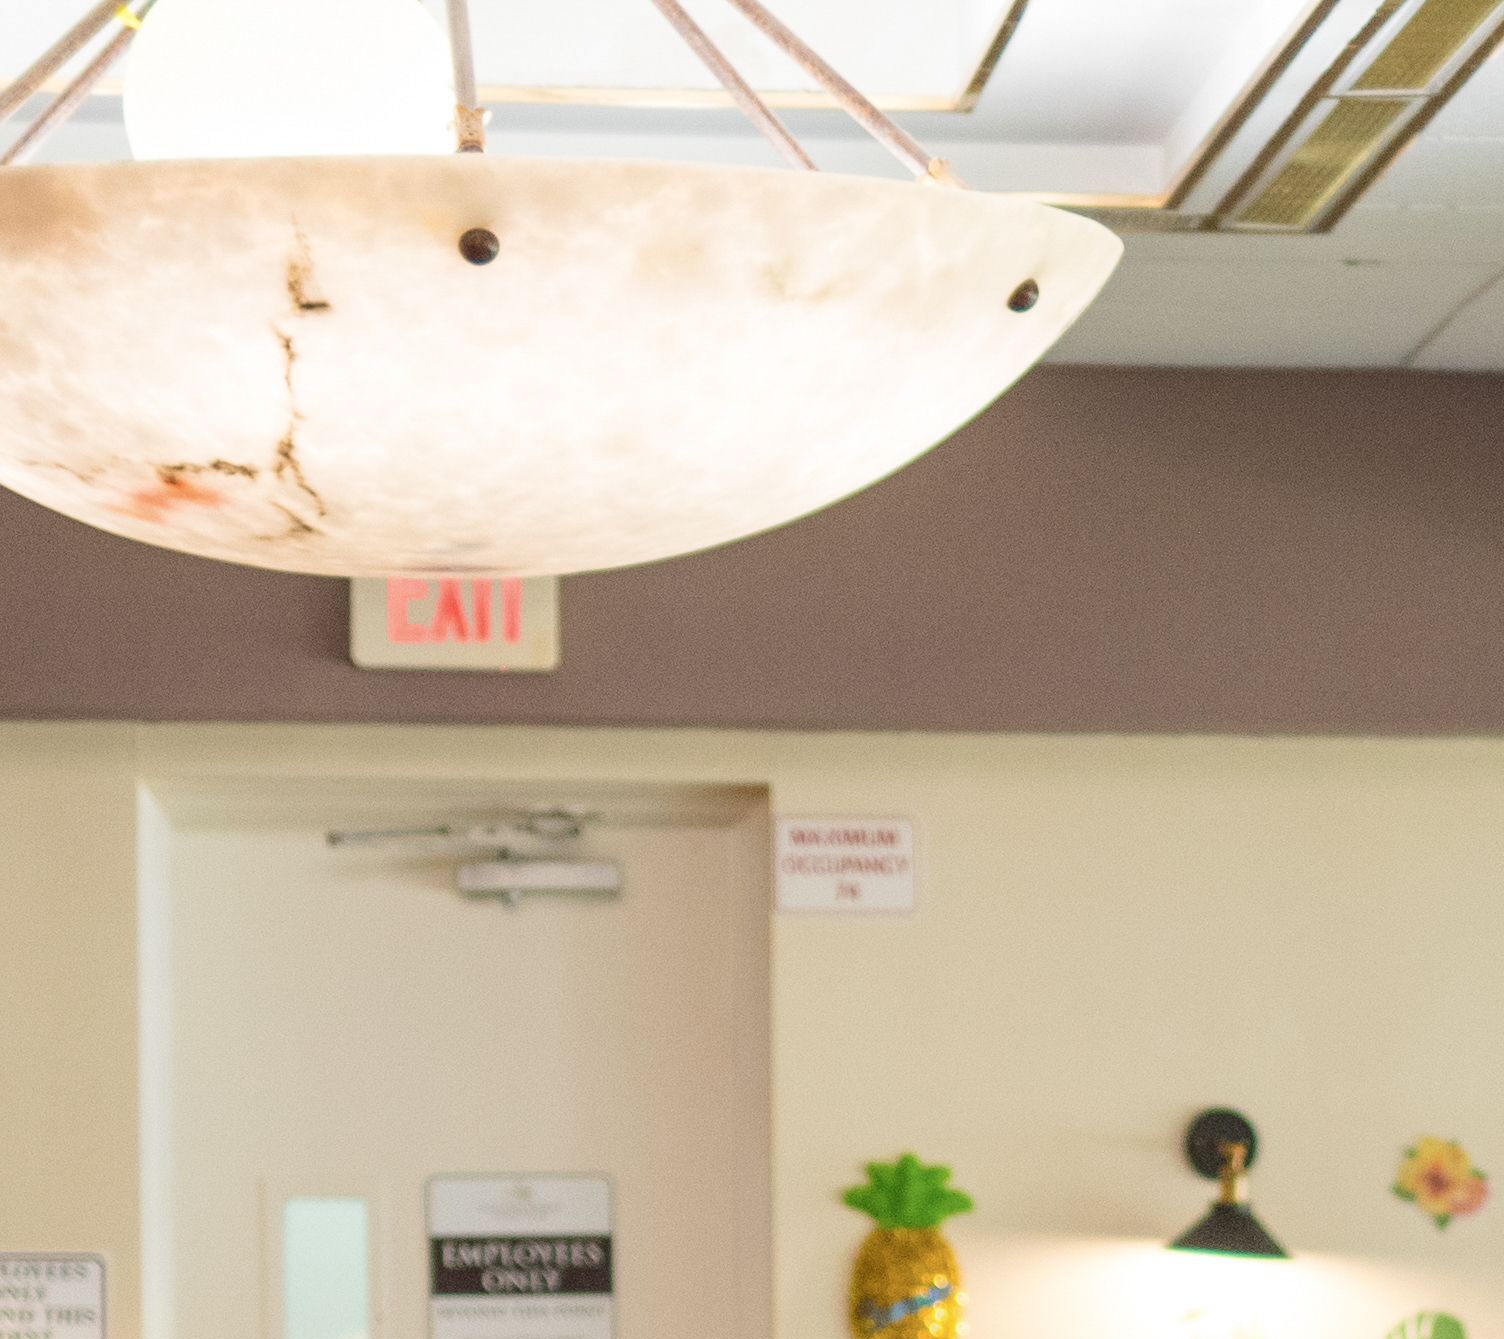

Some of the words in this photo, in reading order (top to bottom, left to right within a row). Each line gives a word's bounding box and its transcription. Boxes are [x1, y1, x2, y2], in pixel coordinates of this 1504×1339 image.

[790, 829, 897, 846] MAXIMUM
[781, 856, 909, 875] OCCUPANCY
[443, 1242, 603, 1268] EMPLOYEES
[481, 1269, 561, 1292] ONLY
[46, 1308, 95, 1322] THIS
